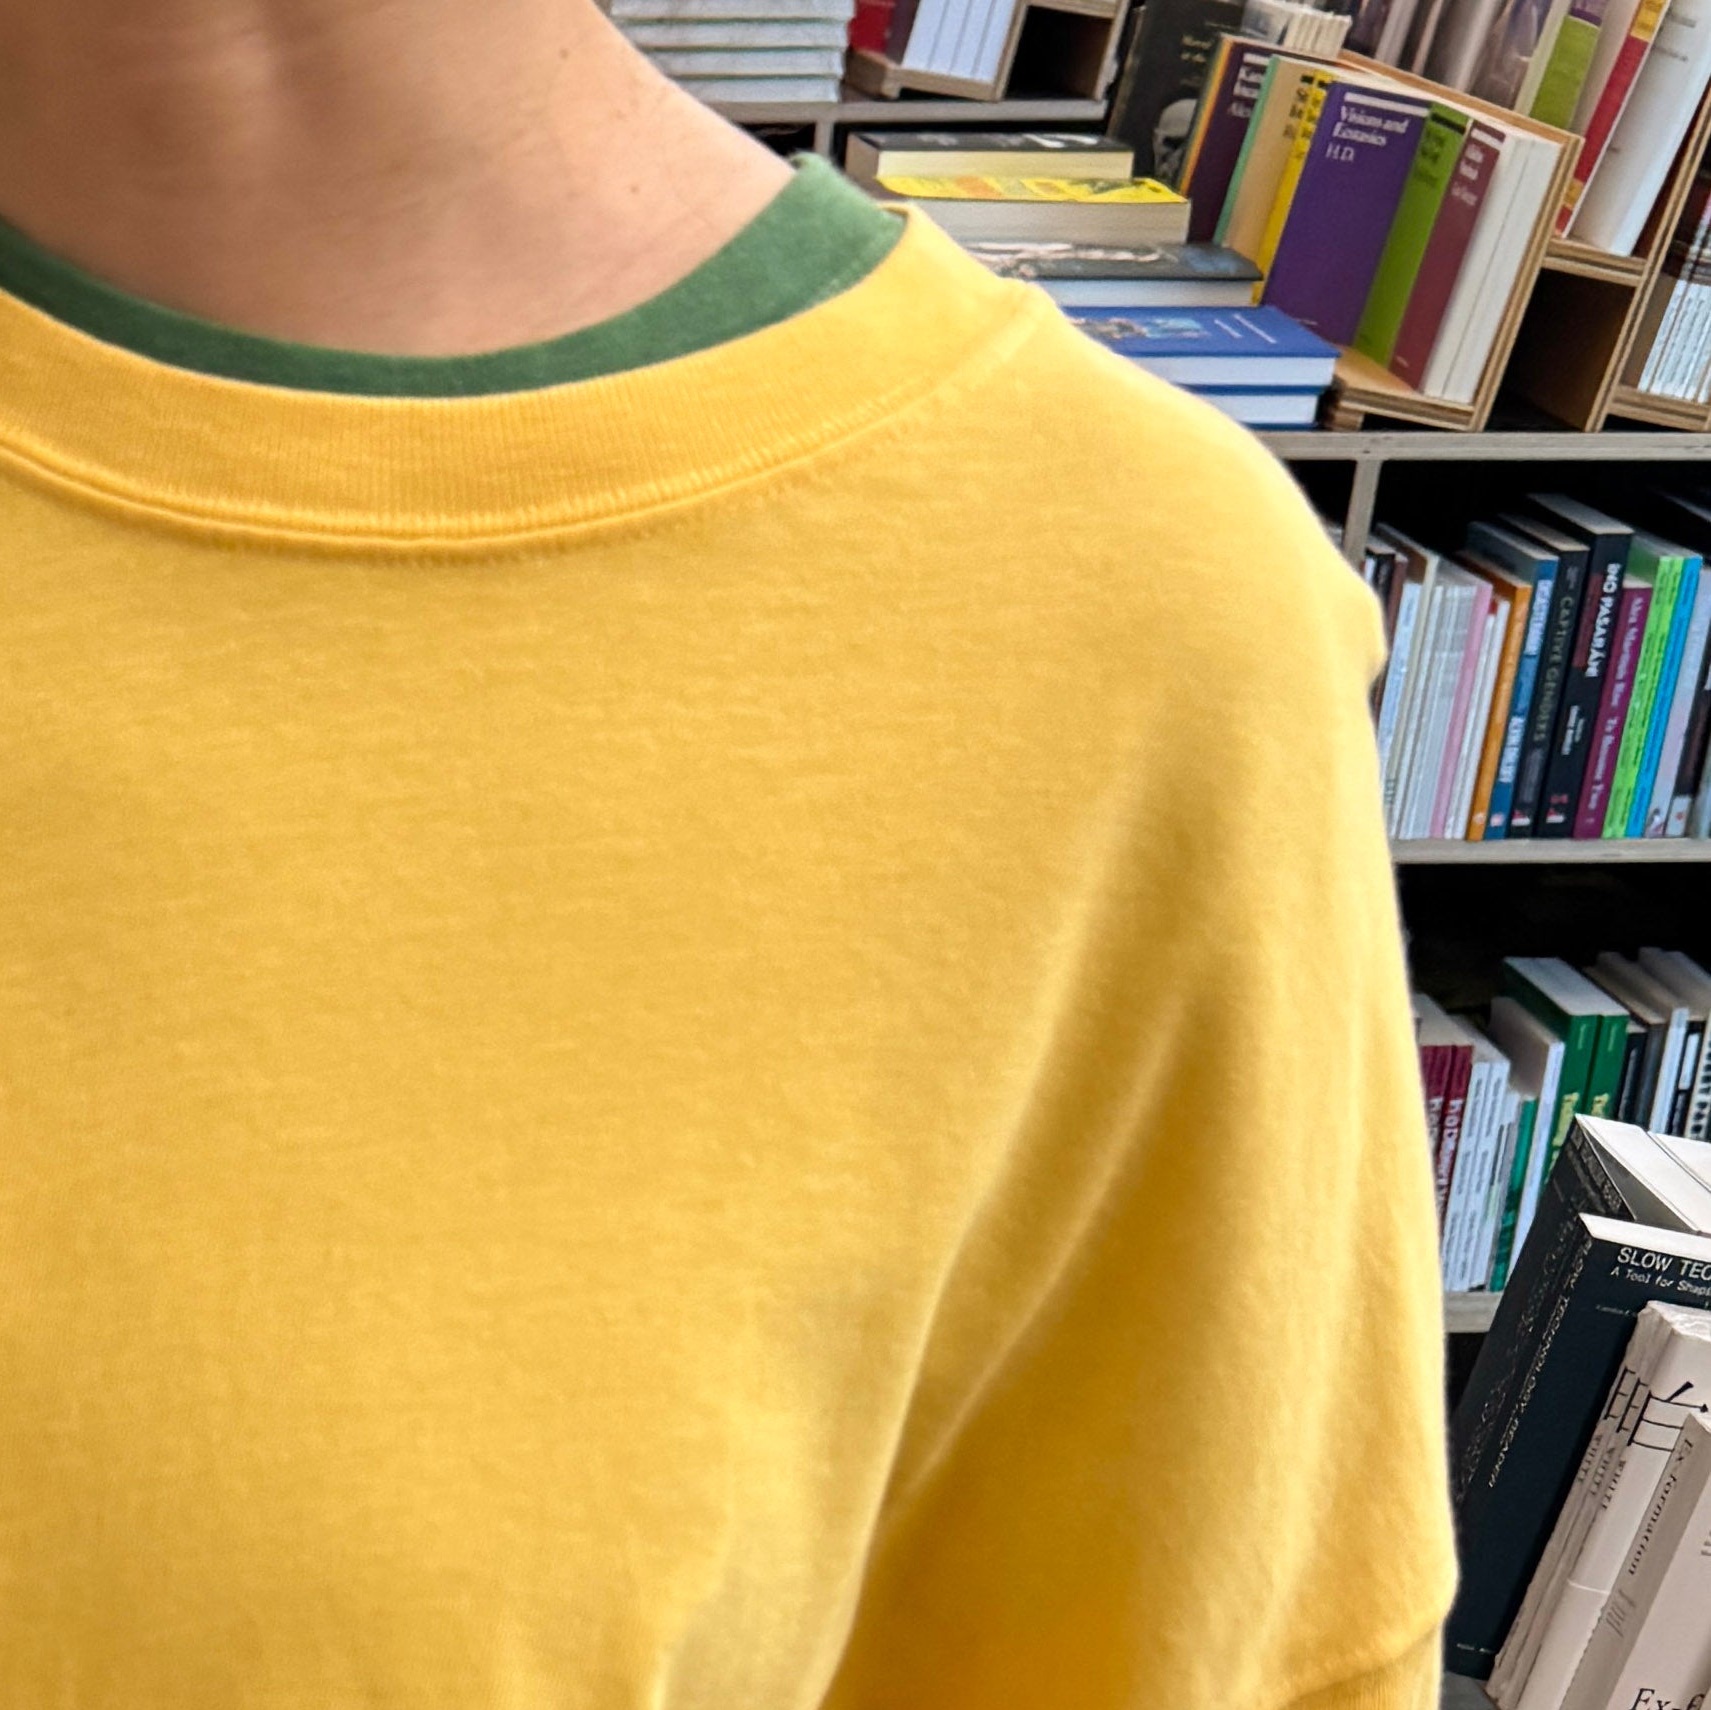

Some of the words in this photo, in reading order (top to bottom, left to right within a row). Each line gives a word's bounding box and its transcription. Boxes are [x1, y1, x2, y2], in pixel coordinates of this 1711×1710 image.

[1617, 1246, 1674, 1272] SLOW
[1610, 1266, 1620, 1276] A
[1625, 1269, 1651, 1284] Tool
[1655, 1275, 1674, 1287] for
